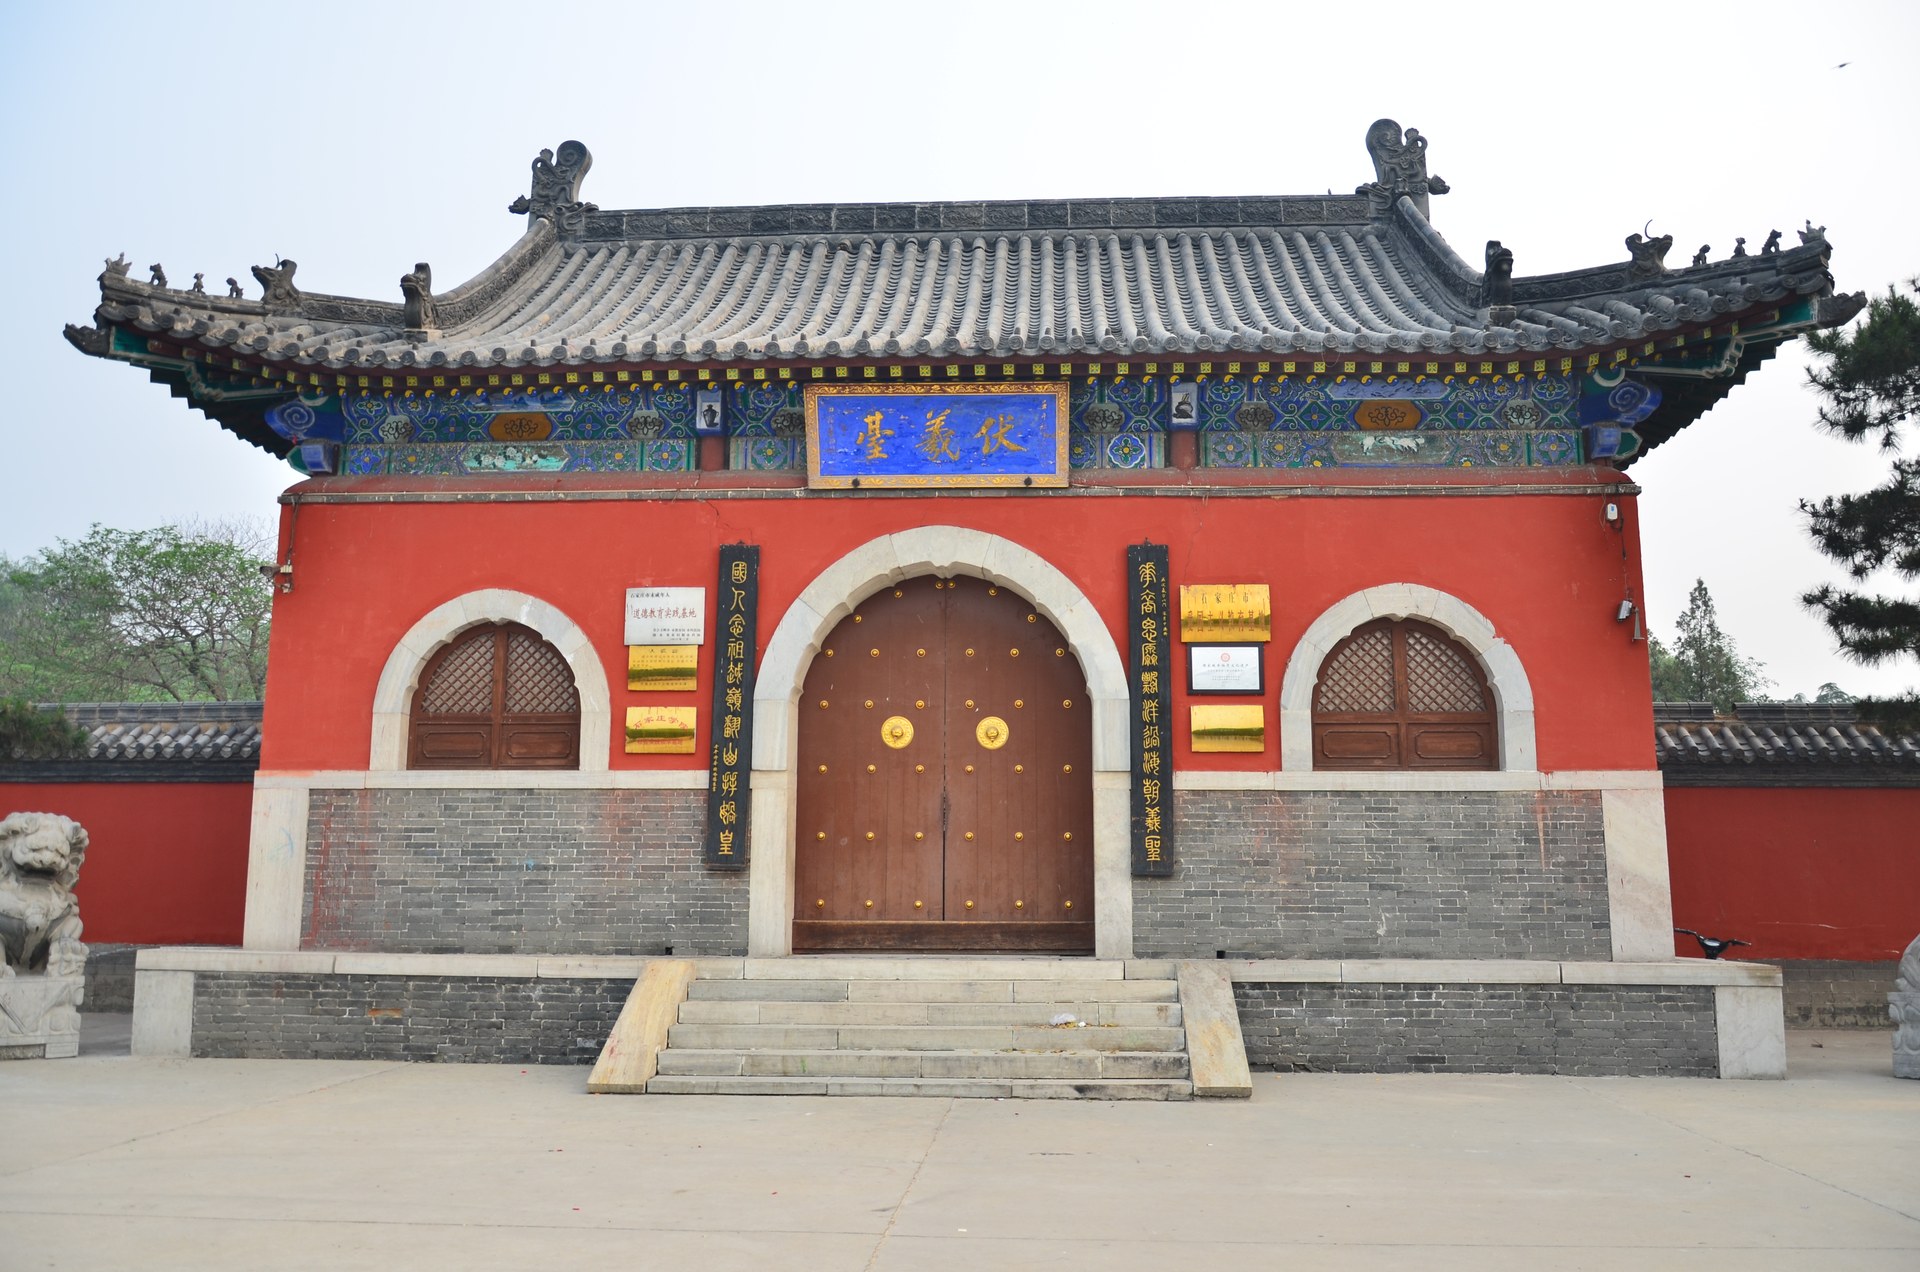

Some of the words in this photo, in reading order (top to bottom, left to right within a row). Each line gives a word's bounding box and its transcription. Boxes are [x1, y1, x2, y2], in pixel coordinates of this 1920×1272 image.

[1201, 591, 1249, 604] 石家庄市
[633, 607, 697, 619] 道德教育实践基地
[633, 715, 689, 731] 石家庄学院
